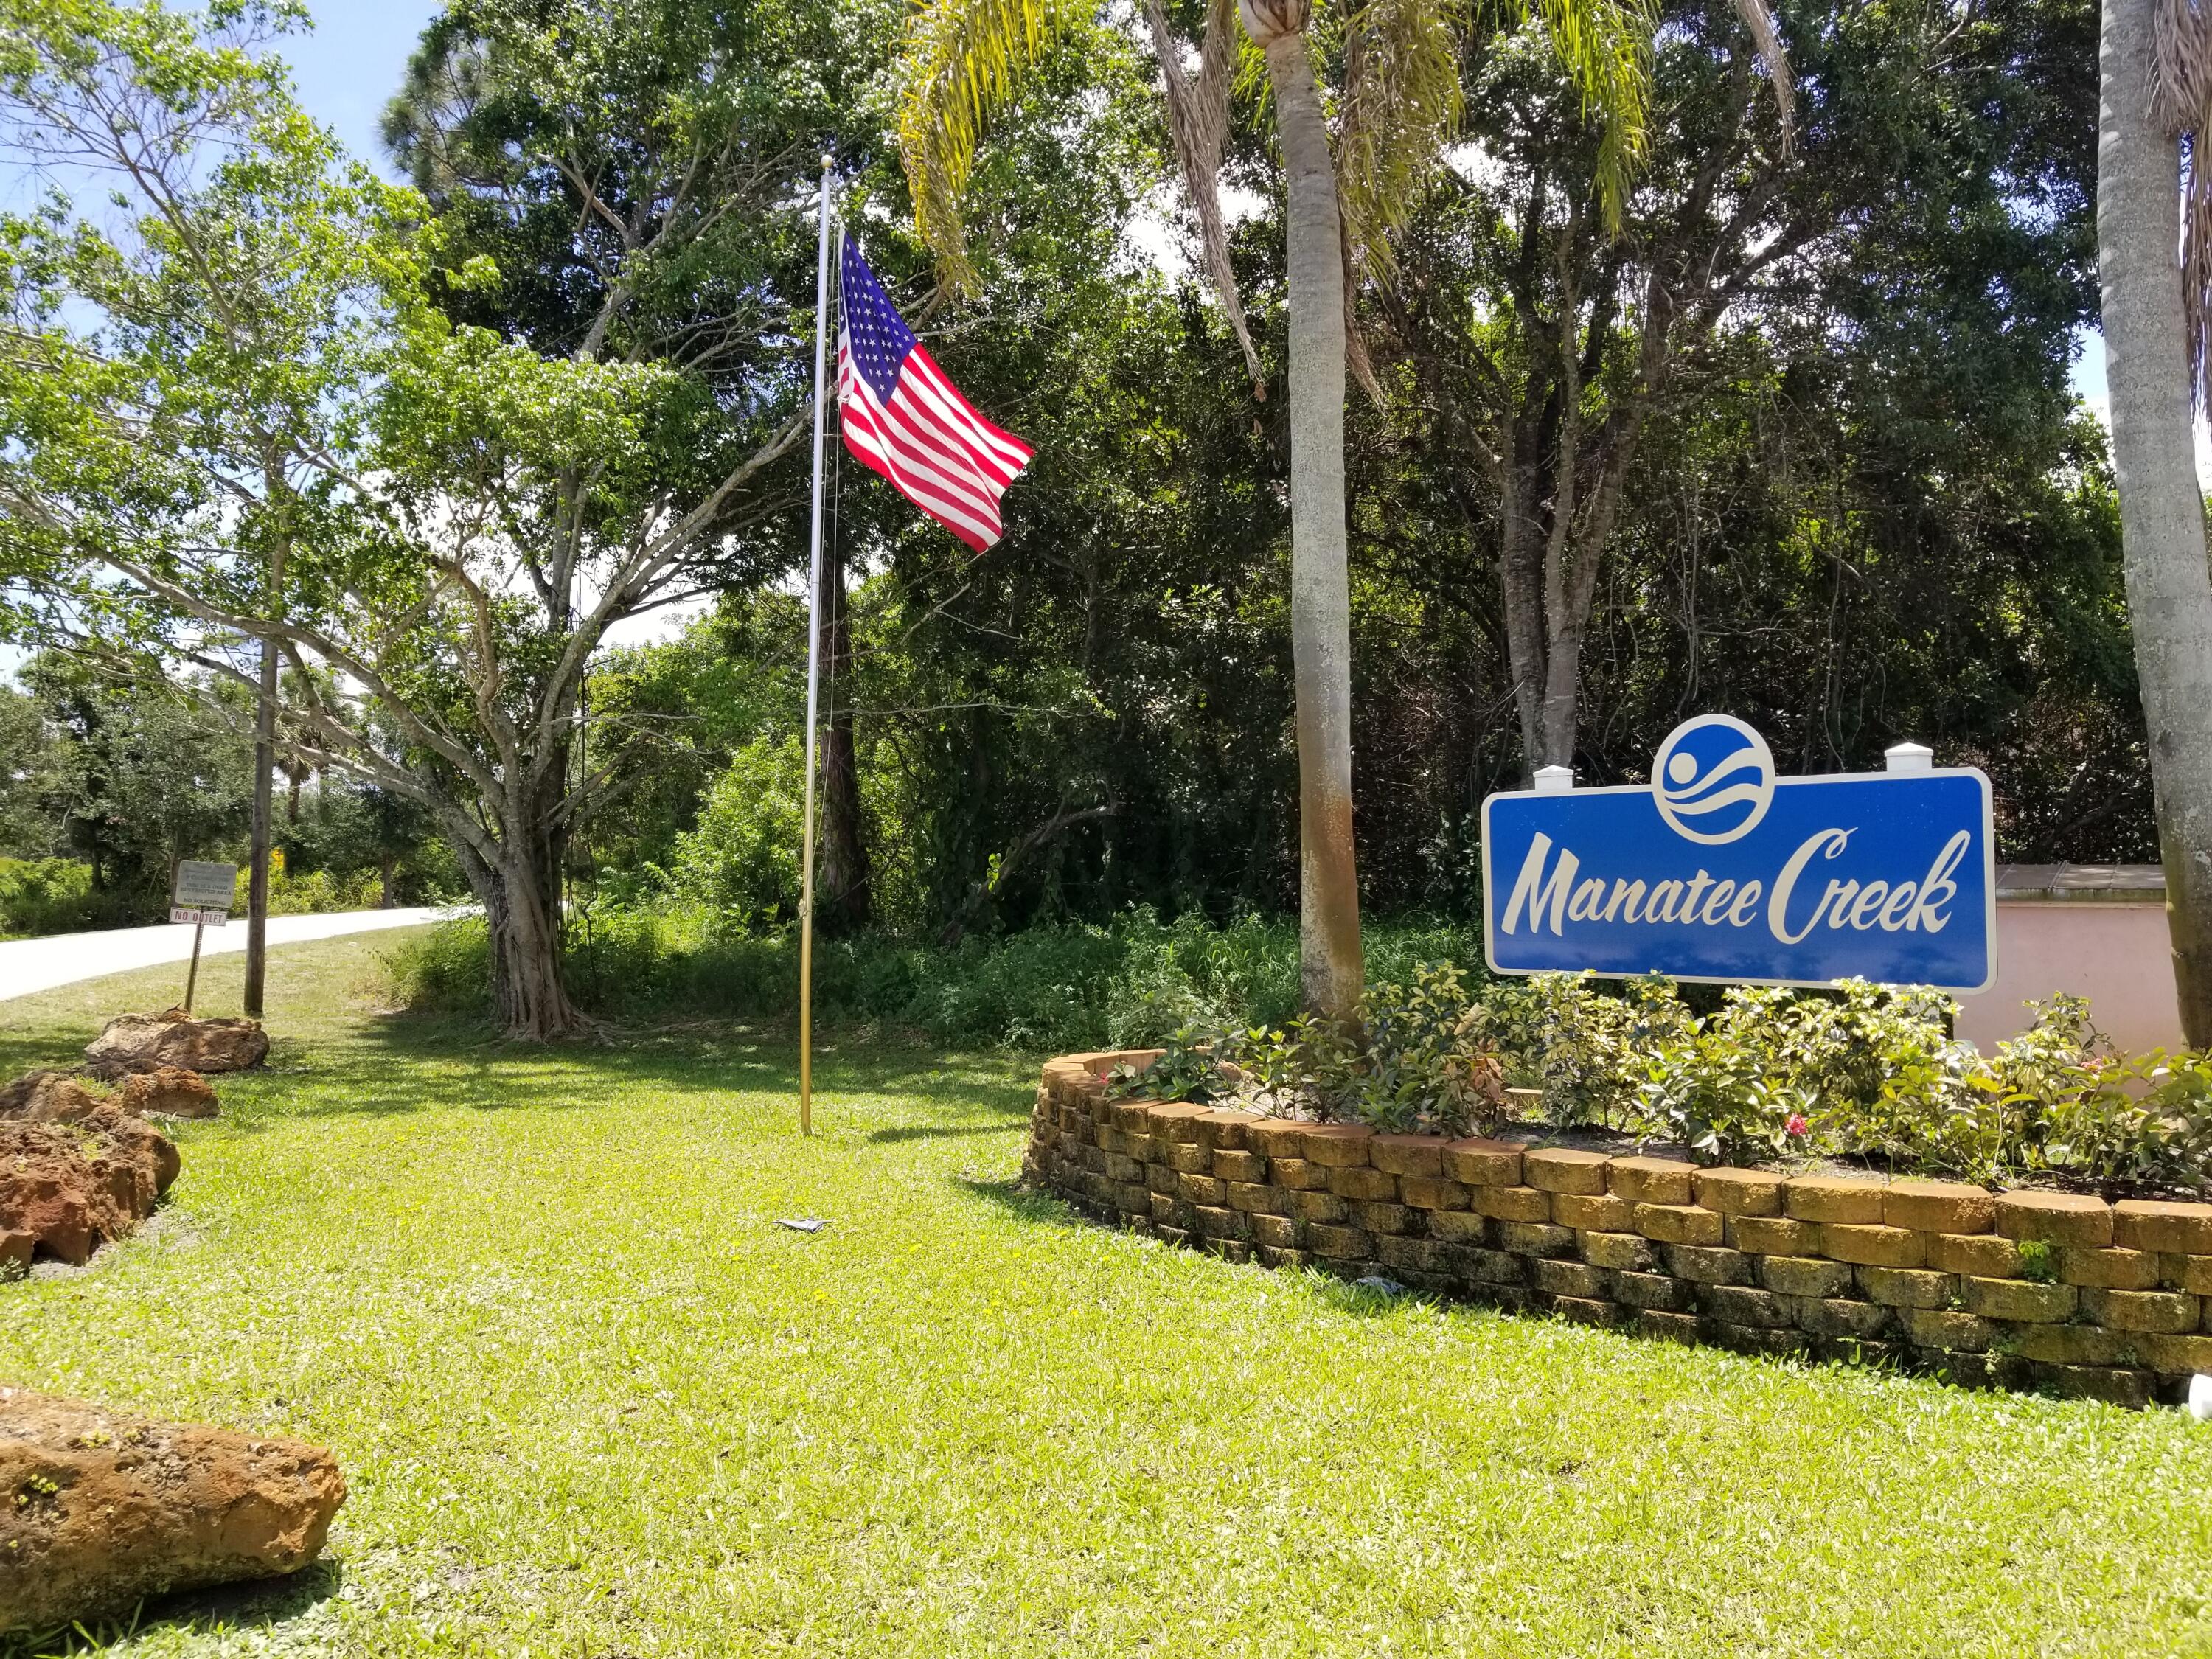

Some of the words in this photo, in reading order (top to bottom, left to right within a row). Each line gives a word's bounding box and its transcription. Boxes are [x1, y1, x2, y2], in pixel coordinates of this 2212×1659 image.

[175, 911, 188, 920] NO
[192, 912, 223, 923] OUTLET
[1501, 832, 1763, 937] Manatee
[1767, 827, 1971, 945] Creek
